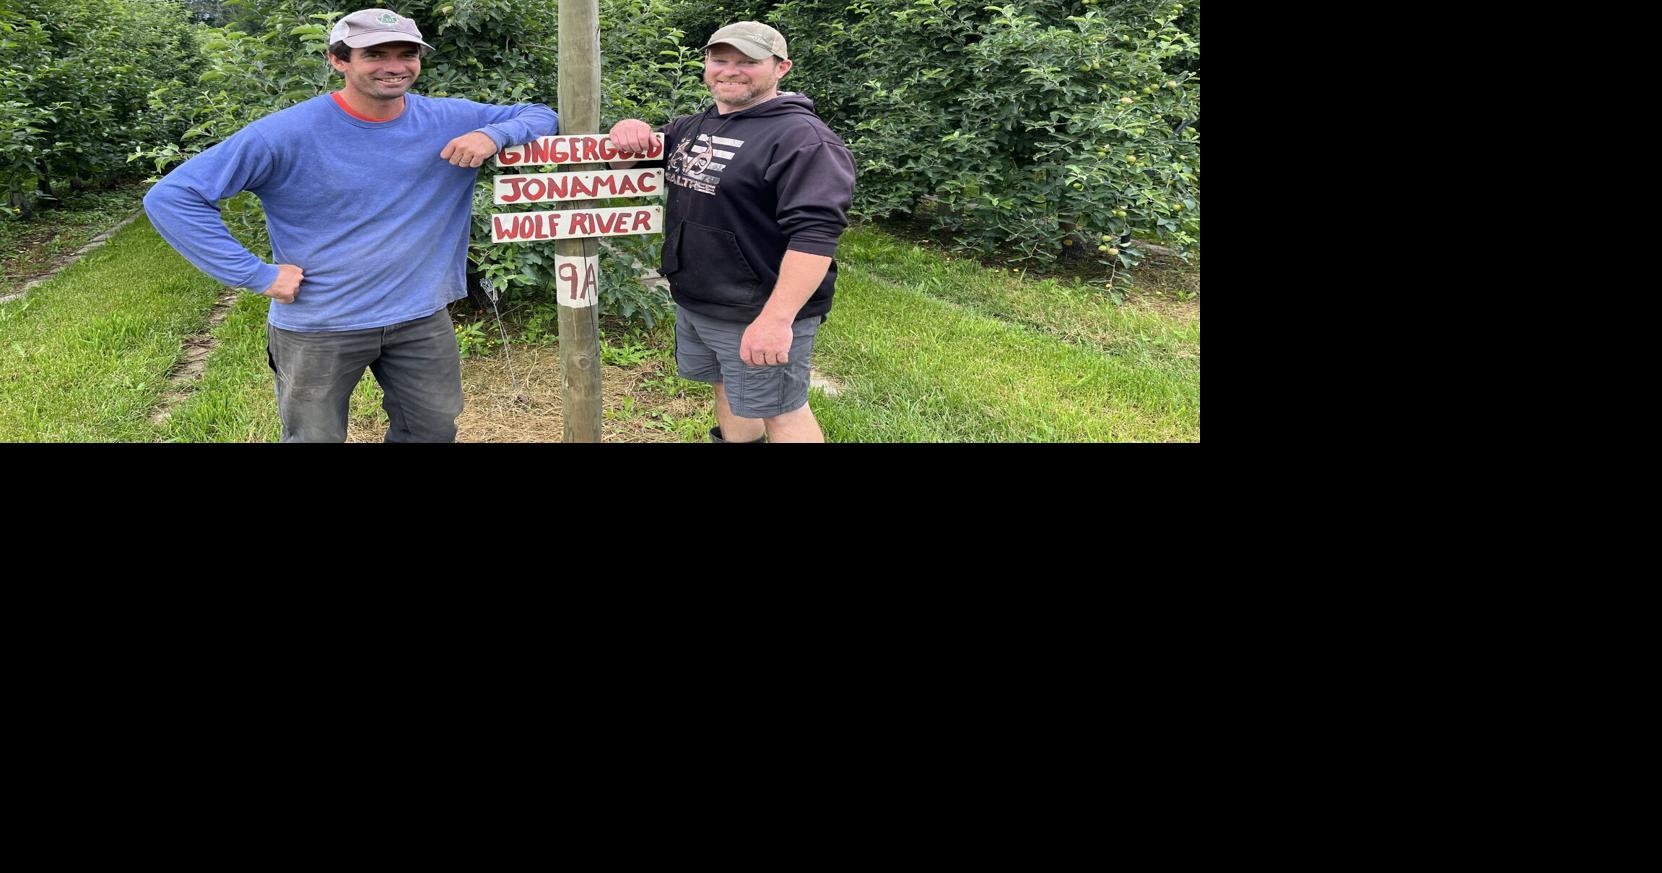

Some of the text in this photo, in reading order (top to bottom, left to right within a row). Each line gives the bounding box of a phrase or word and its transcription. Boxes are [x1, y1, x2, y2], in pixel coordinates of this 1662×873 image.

[499, 137, 663, 165] GINGERGD
[500, 172, 657, 202] JONAMAC
[493, 210, 652, 240] WOLF RIVER
[558, 262, 598, 301] 9A
